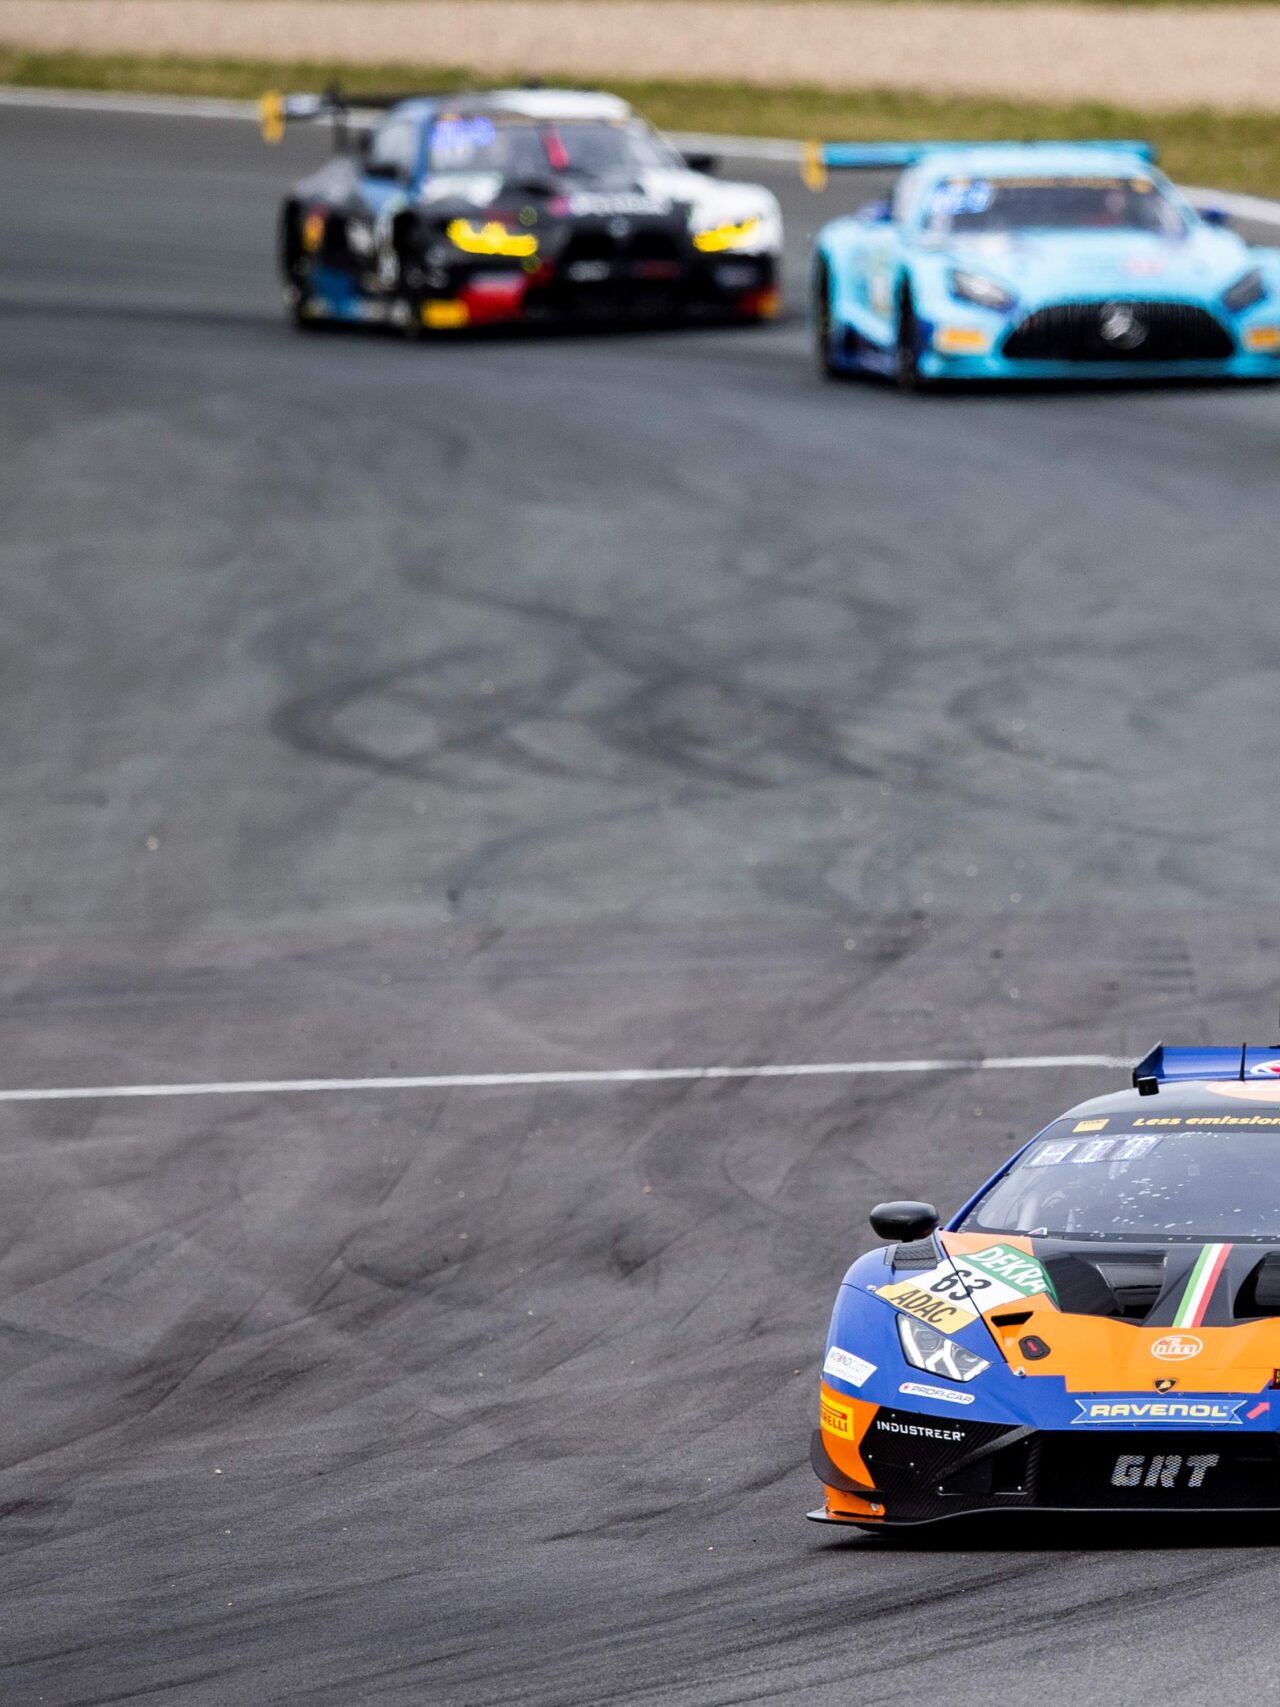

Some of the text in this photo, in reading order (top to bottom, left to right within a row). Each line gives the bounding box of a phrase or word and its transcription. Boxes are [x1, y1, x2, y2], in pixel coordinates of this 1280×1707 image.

[1132, 1117, 1182, 1127] Less
[967, 1246, 1047, 1293] DEKRA
[930, 1269, 992, 1301] 63
[889, 1289, 958, 1323] ADAC
[911, 1385, 972, 1403] PROFI-CAR
[1090, 1403, 1228, 1417] RAVENOL
[876, 1420, 962, 1441] INDUSTREER
[1110, 1454, 1220, 1488] GRT
